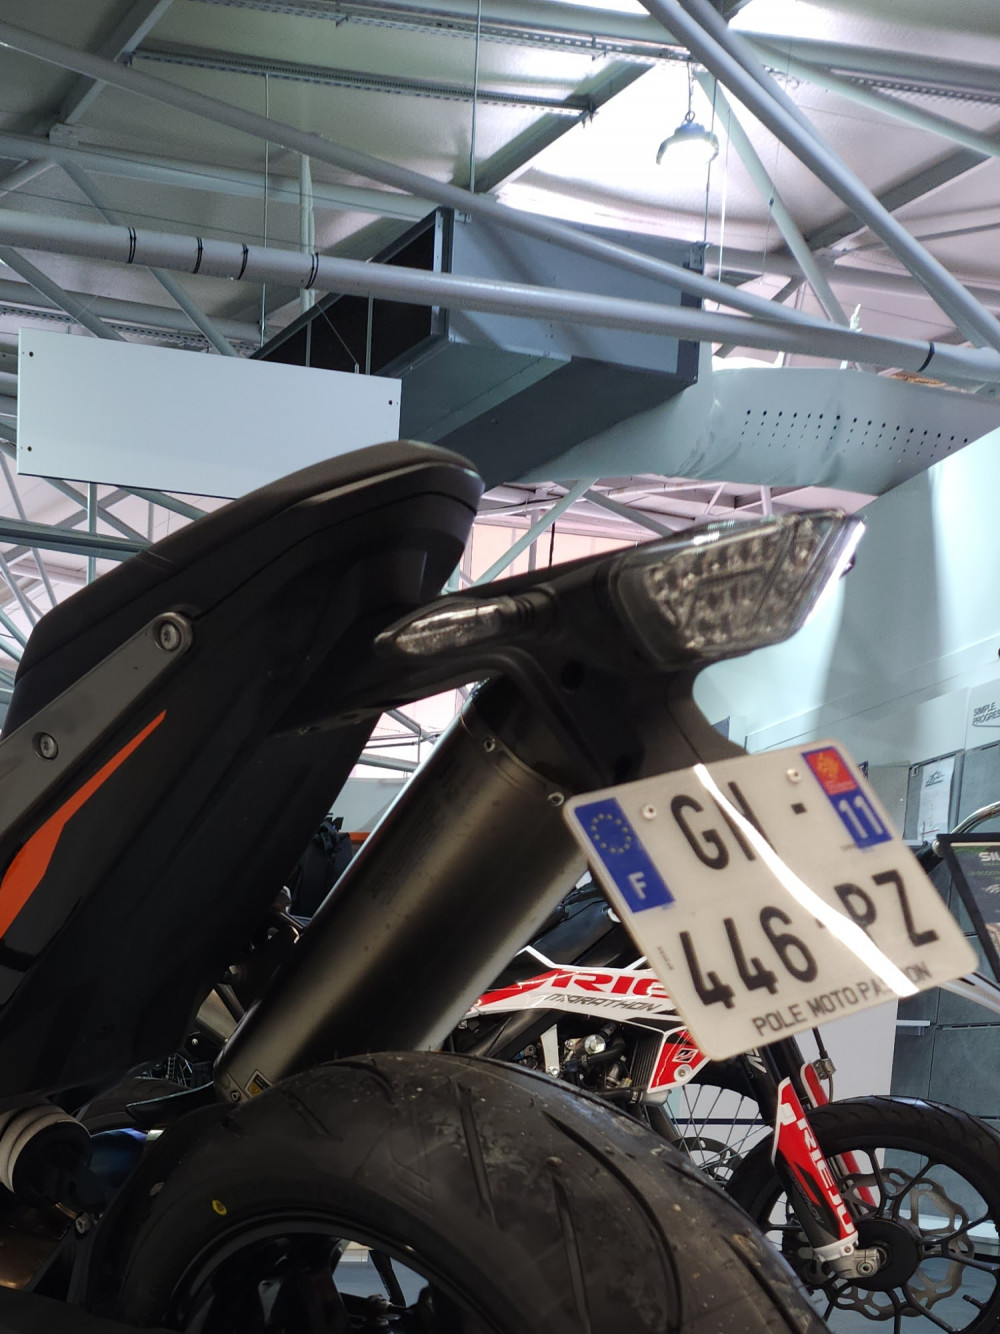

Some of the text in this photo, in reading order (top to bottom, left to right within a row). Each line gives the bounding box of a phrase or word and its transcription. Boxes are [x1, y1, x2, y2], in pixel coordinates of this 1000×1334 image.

[973, 702, 996, 717] SIMPLE
[838, 795, 883, 839] 11
[627, 871, 648, 899] F
[751, 961, 933, 1037] POLE MOTO PAON
[796, 1117, 857, 1235] RIEJU
